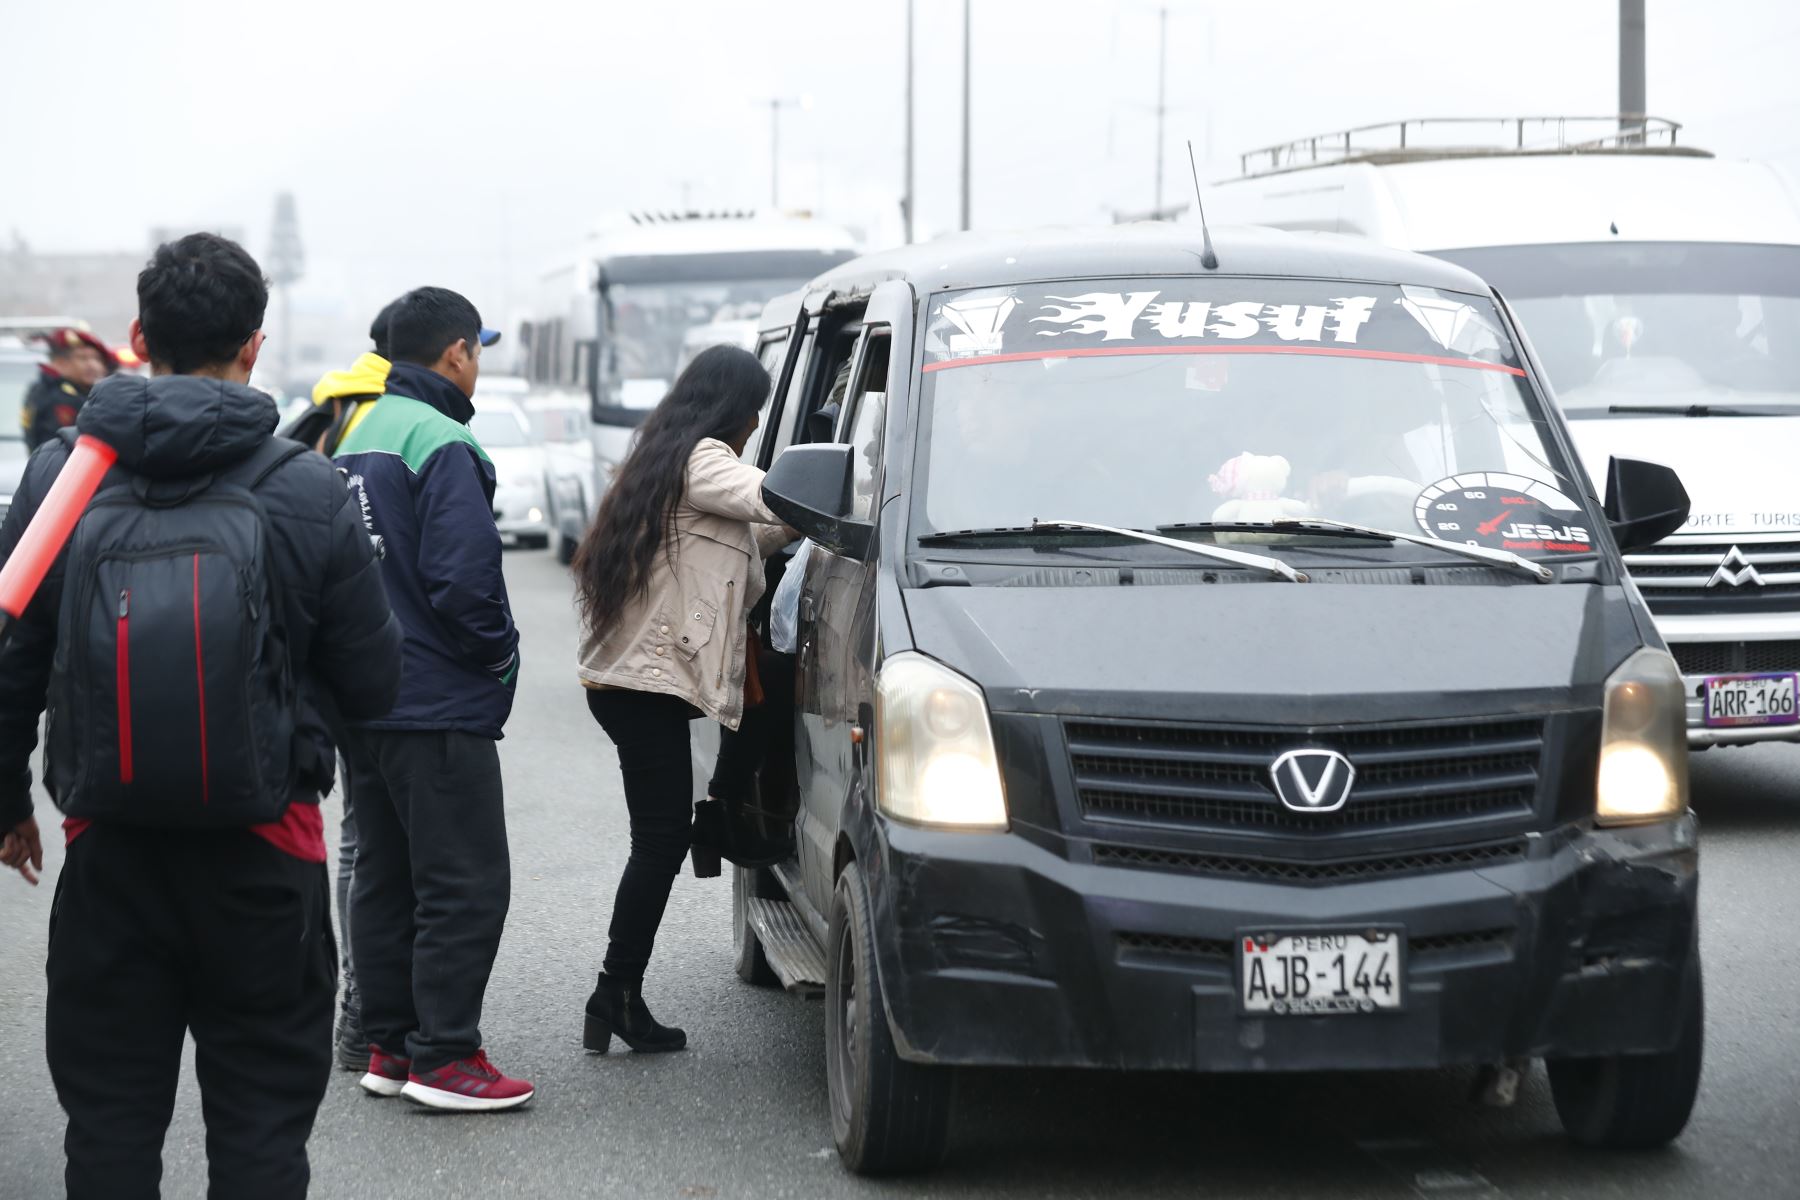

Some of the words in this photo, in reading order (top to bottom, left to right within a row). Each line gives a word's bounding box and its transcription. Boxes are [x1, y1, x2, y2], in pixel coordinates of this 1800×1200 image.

[1030, 290, 1377, 343] Yusuf
[1437, 522, 1461, 531] 20
[1501, 523, 1591, 543] JESUS
[1711, 687, 1793, 717] ARR-166
[1291, 935, 1348, 952] PERU
[1248, 951, 1393, 1001] AJB-144
